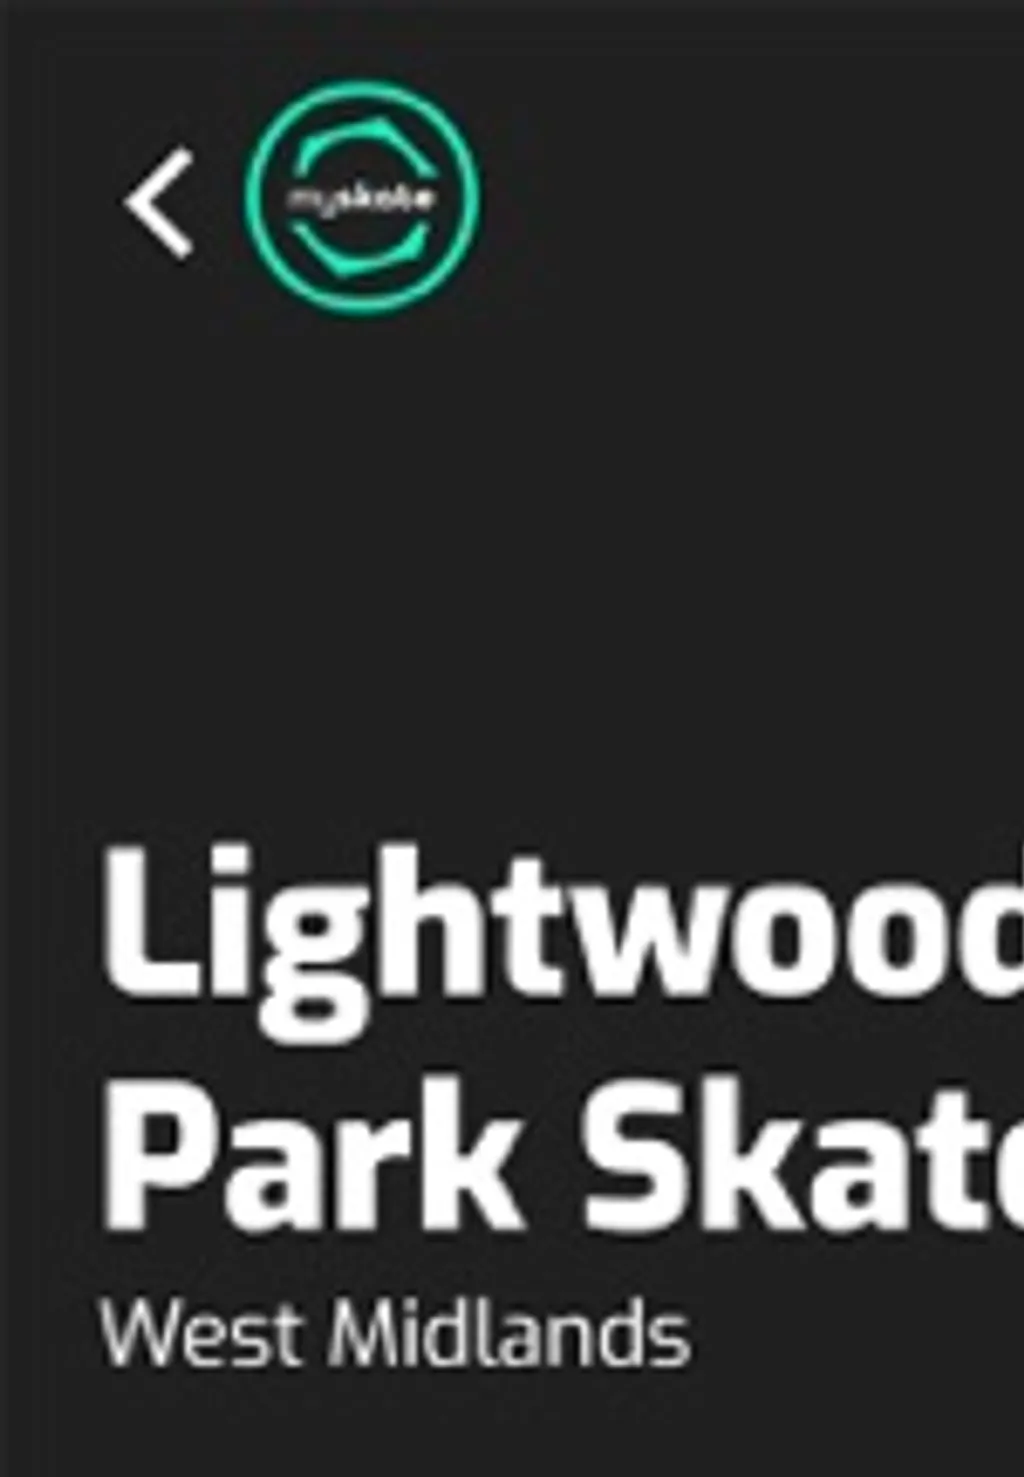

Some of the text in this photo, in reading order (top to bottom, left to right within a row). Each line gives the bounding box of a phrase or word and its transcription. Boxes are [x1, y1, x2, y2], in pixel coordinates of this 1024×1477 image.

[106, 1075, 526, 1233] Park
[101, 1296, 691, 1367] West Midlands
